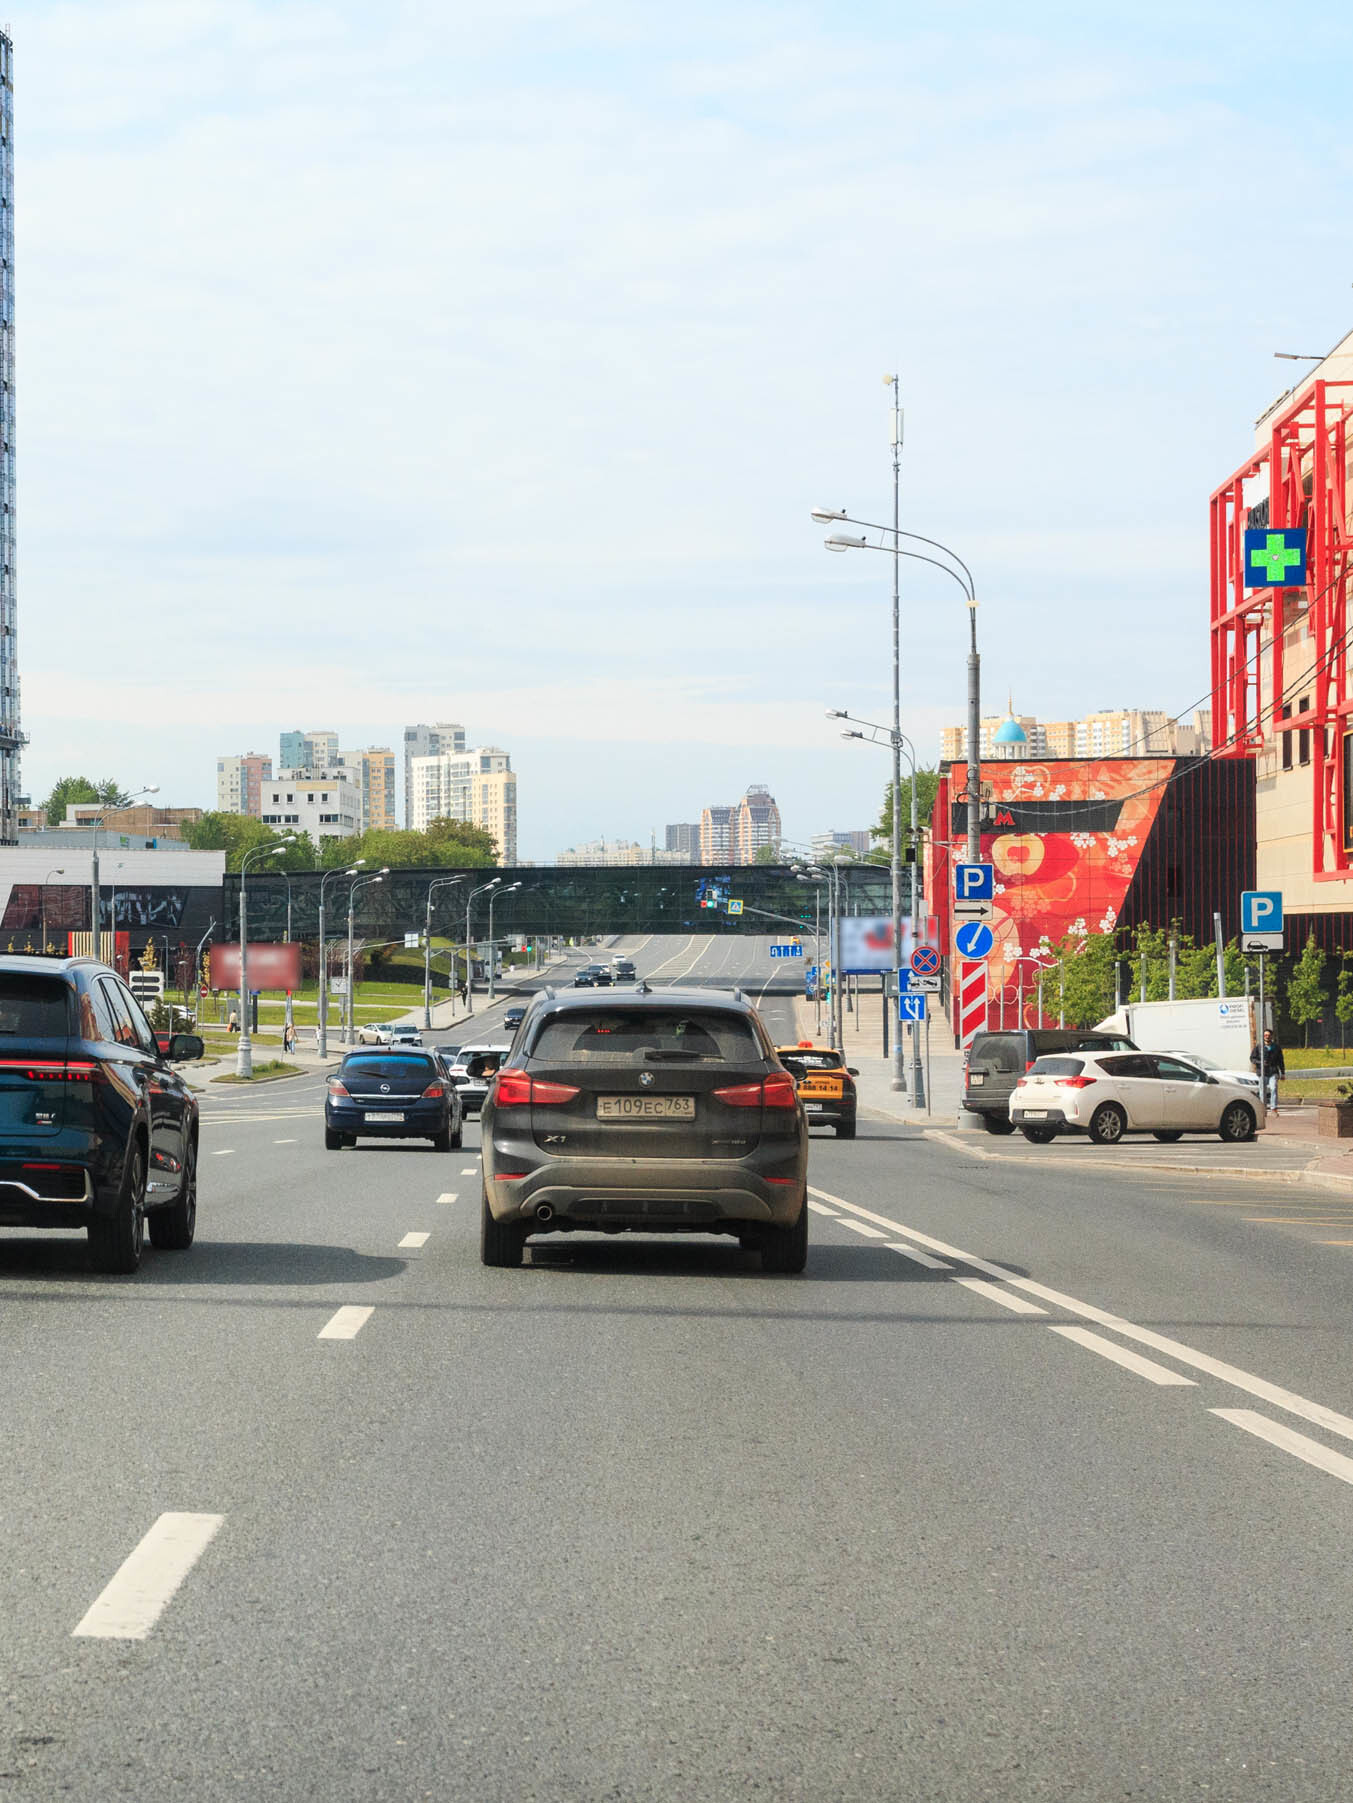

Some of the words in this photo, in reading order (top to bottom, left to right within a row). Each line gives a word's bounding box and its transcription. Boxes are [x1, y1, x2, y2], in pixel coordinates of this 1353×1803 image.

[963, 868, 985, 897] P
[1250, 897, 1274, 927] P
[666, 1098, 690, 1110] 763
[543, 1135, 567, 1143] X1
